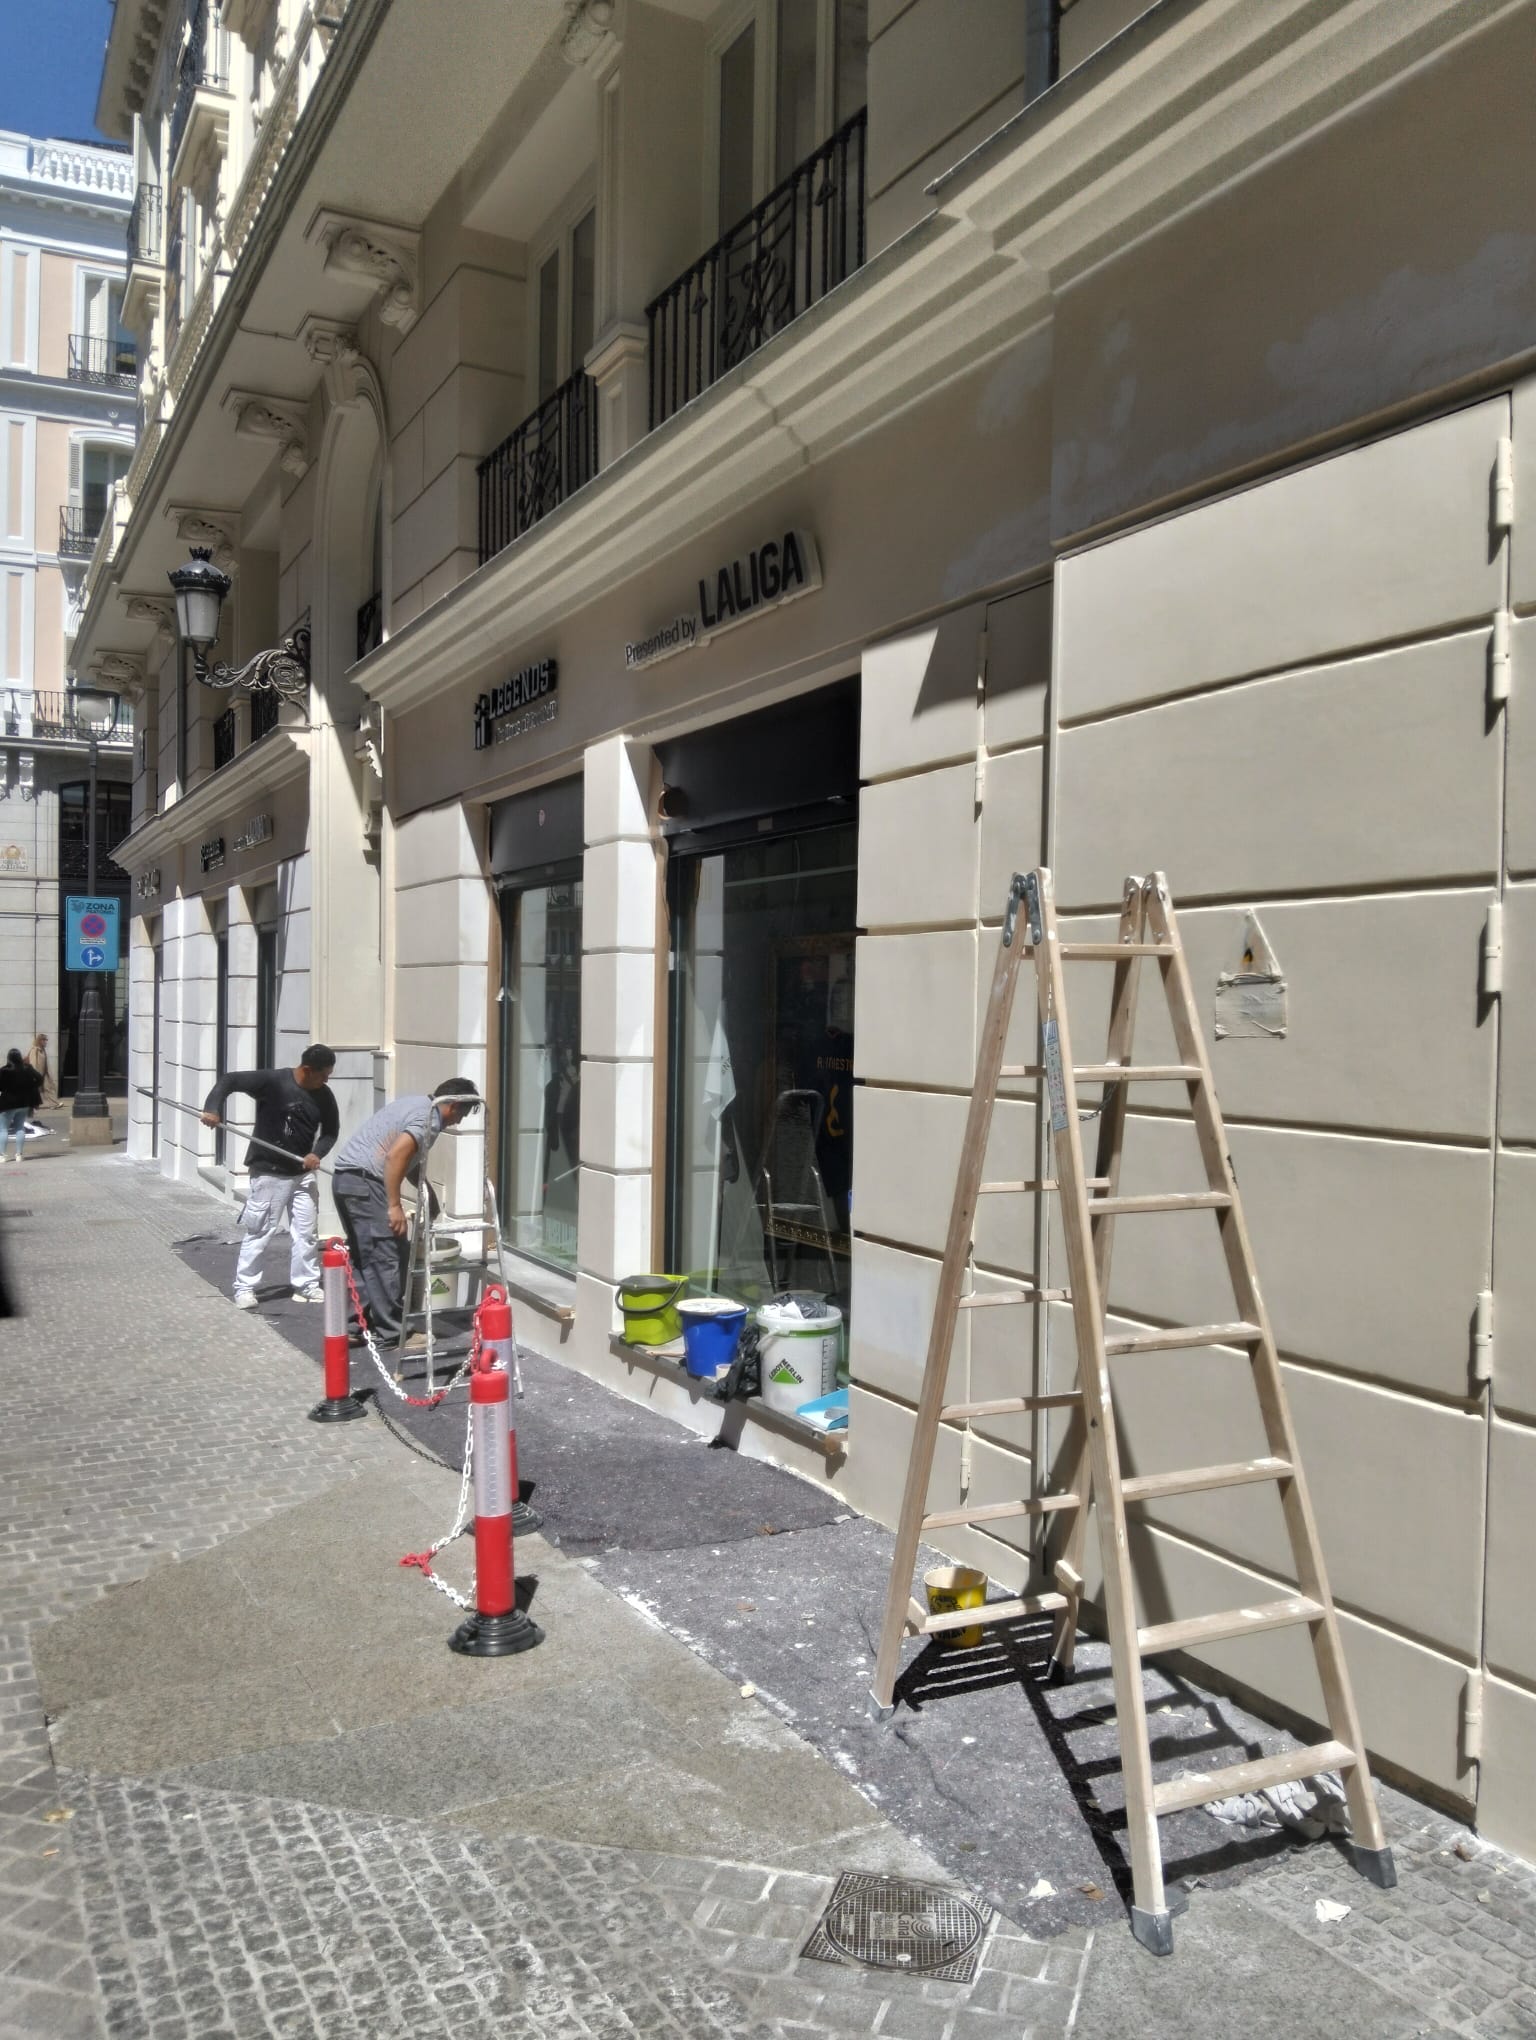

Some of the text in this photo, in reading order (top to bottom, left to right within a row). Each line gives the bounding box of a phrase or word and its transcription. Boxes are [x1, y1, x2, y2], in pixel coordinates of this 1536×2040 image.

[625, 531, 804, 665] Presented by LALIGA
[488, 657, 552, 720] LEGENDS
[86, 902, 115, 911] ZONA
[782, 1358, 804, 1384] MERLIN
[898, 1912, 915, 1939] Canal
